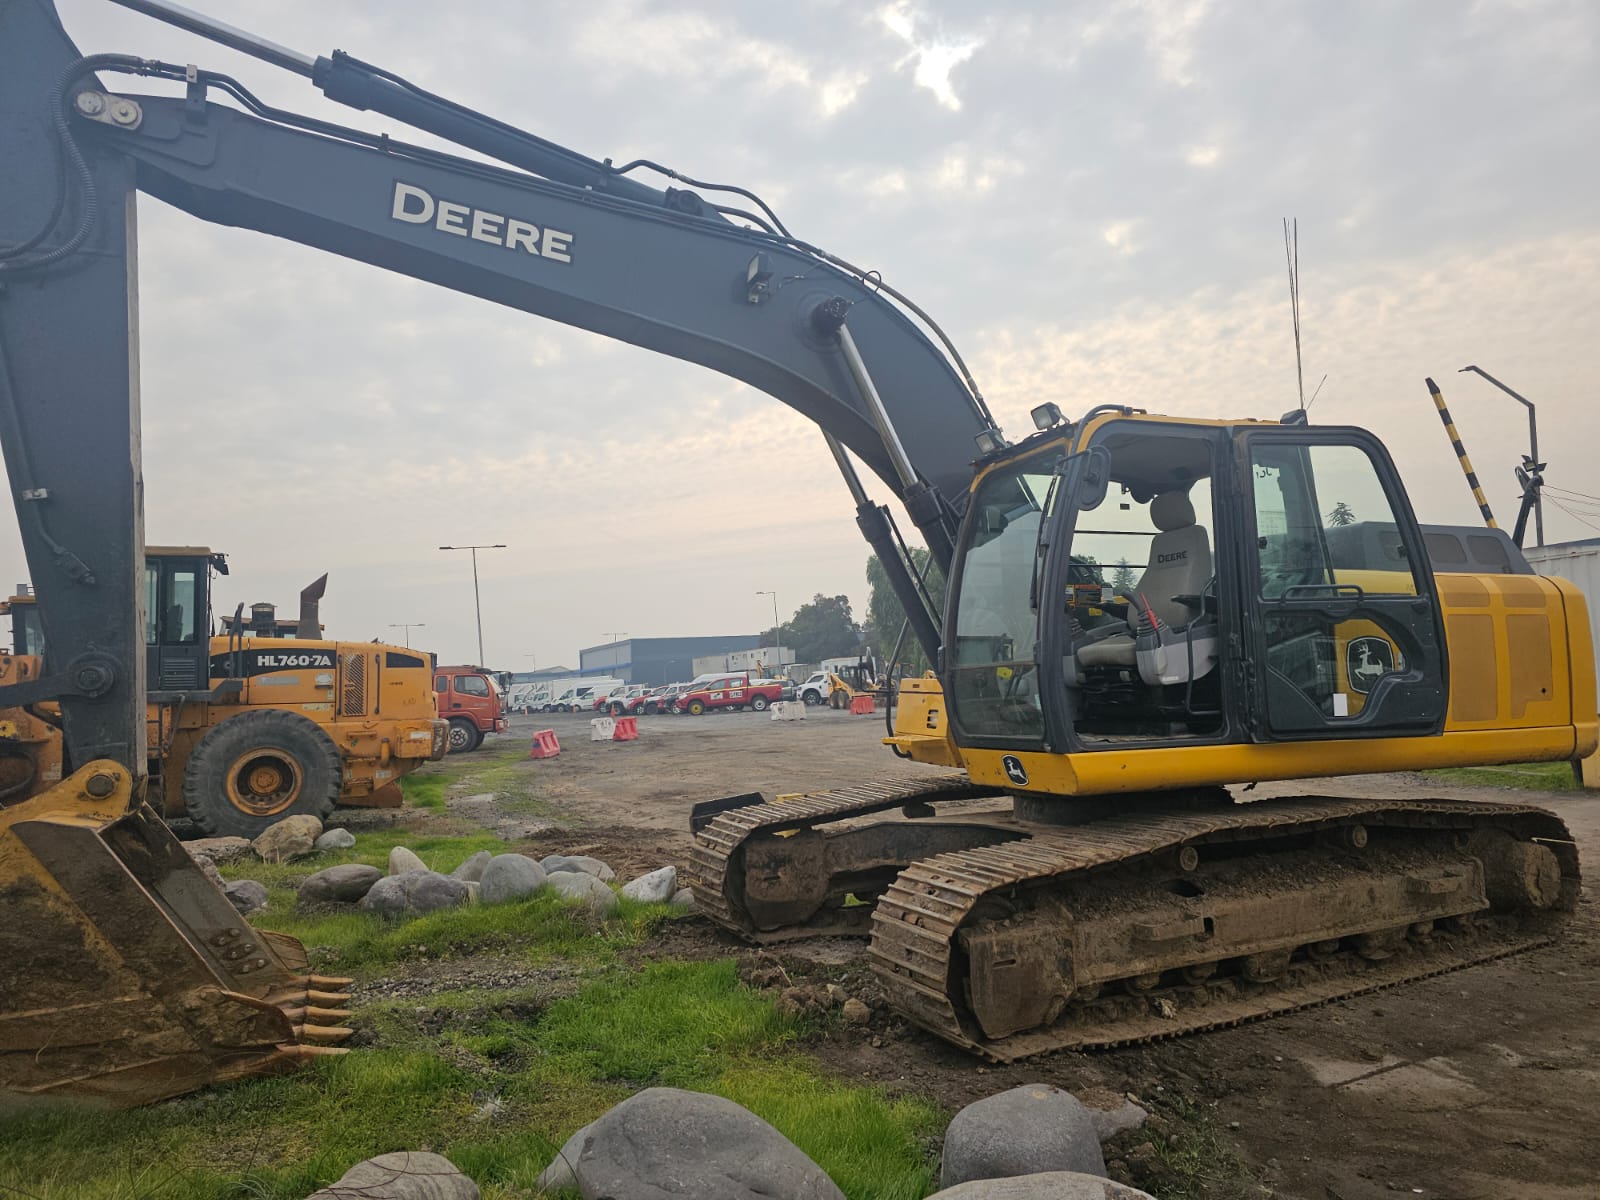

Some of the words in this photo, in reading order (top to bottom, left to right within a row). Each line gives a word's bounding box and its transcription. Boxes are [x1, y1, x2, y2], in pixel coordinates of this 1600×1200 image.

[392, 182, 573, 263] DEERE
[1157, 550, 1188, 564] DEERE
[257, 655, 332, 666] HL760-7A
